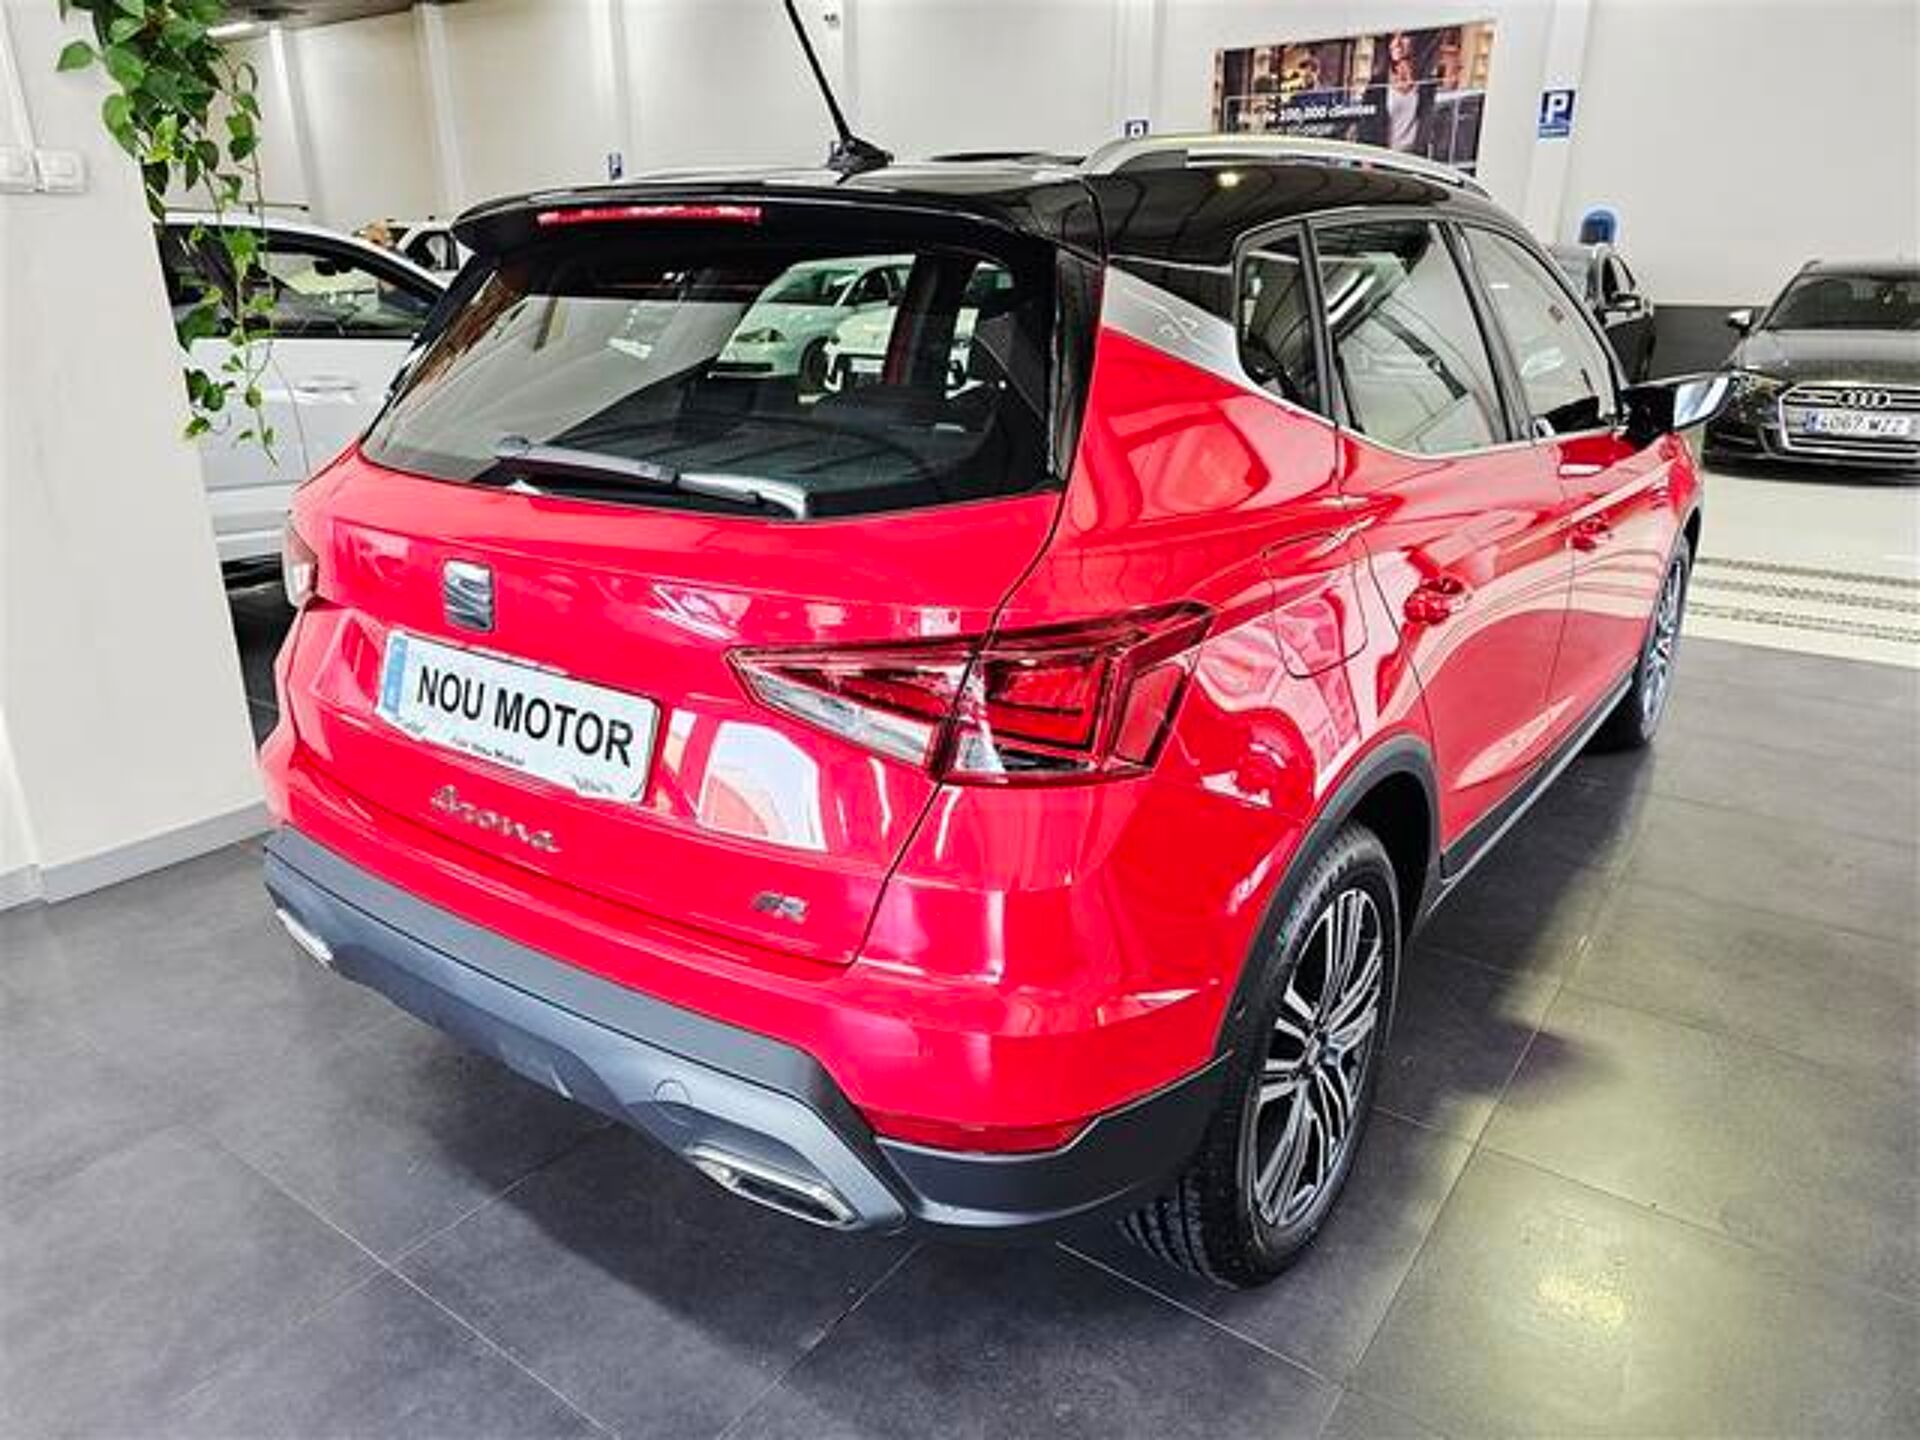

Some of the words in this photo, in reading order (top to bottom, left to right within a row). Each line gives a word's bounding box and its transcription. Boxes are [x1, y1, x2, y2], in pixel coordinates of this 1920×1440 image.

[1547, 93, 1569, 123] P
[416, 665, 484, 720] NOU
[493, 687, 632, 768] MOTOR
